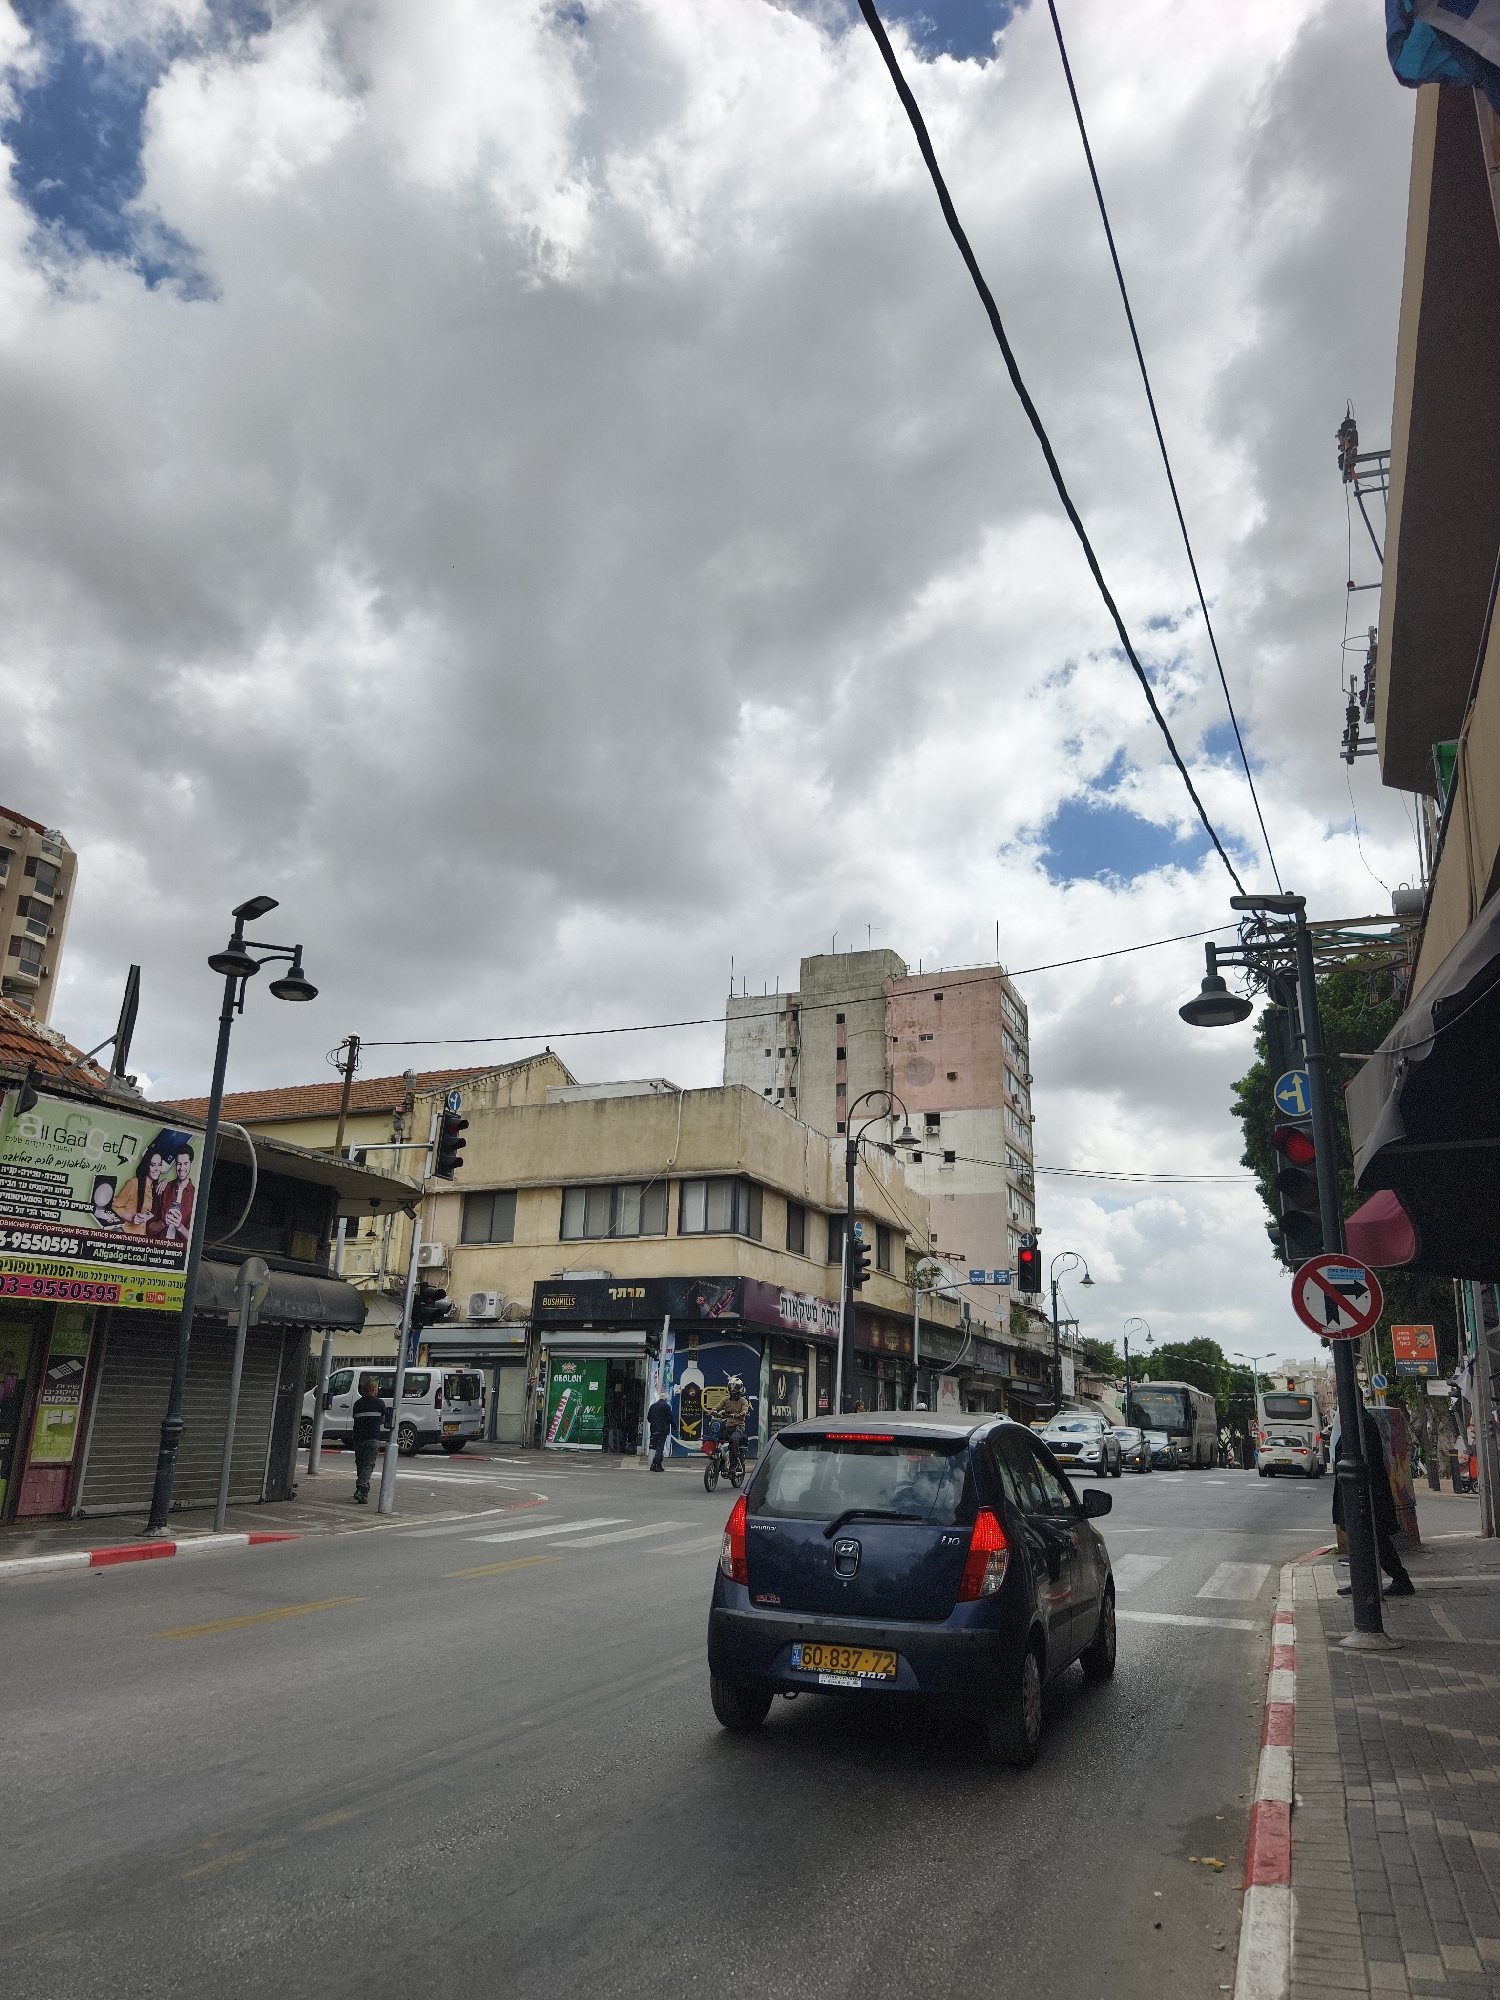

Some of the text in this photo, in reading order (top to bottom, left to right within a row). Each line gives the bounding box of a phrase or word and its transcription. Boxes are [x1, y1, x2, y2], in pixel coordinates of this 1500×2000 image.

[91, 1270, 102, 1280] לכל
[543, 1297, 576, 1307] BUSHMILLS
[780, 1296, 817, 1324] משקאות
[43, 1395, 79, 1404] במקום
